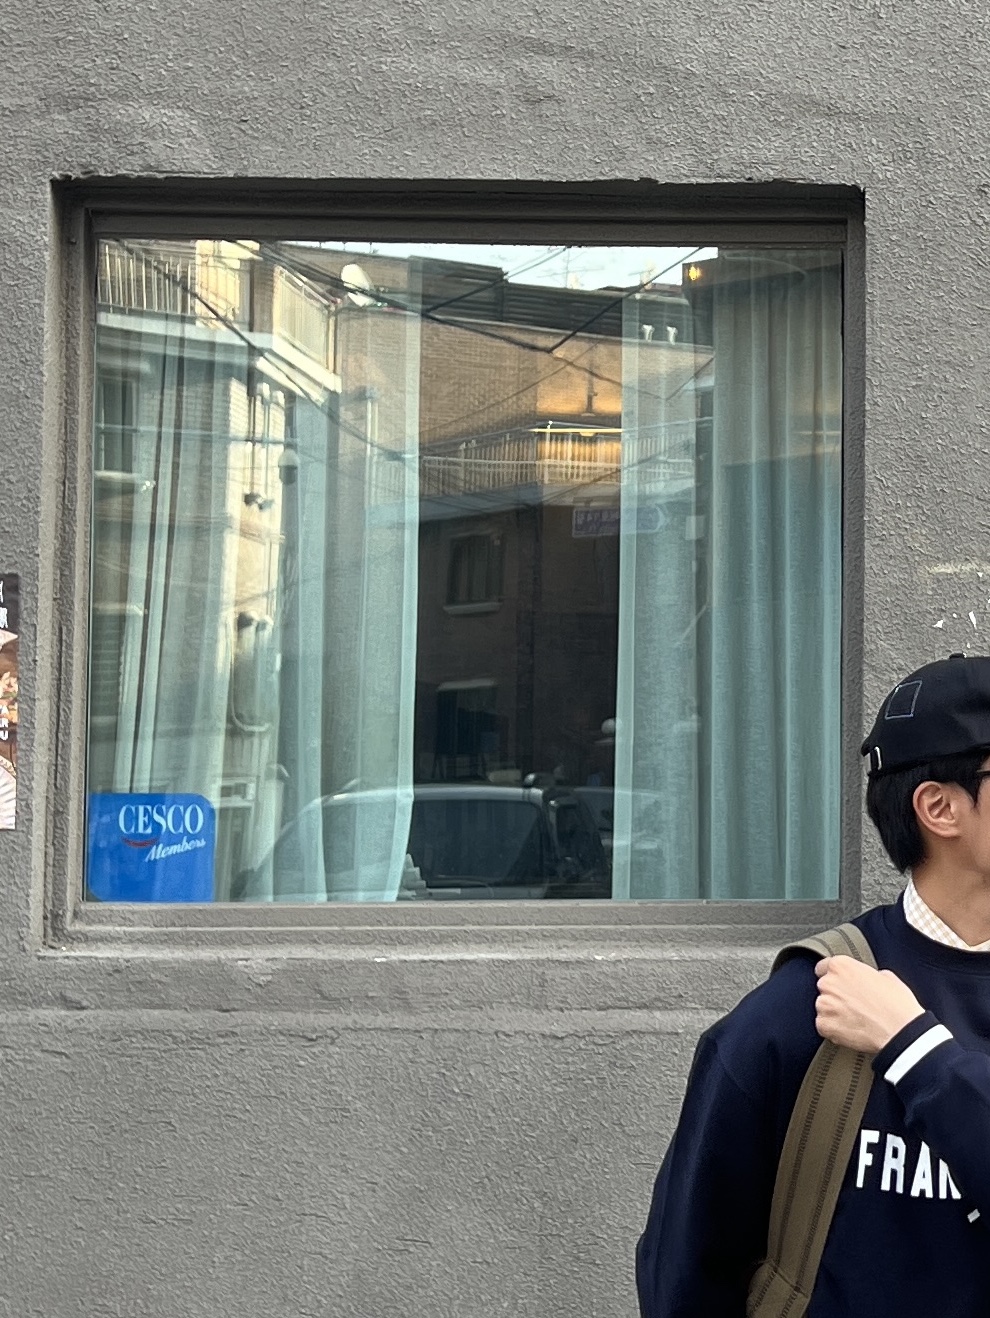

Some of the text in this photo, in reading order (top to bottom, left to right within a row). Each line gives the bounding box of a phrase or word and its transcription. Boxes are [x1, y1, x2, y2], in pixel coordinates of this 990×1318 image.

[118, 803, 204, 834] CESCO
[144, 836, 206, 863] Members
[856, 1129, 980, 1223] FRAN
